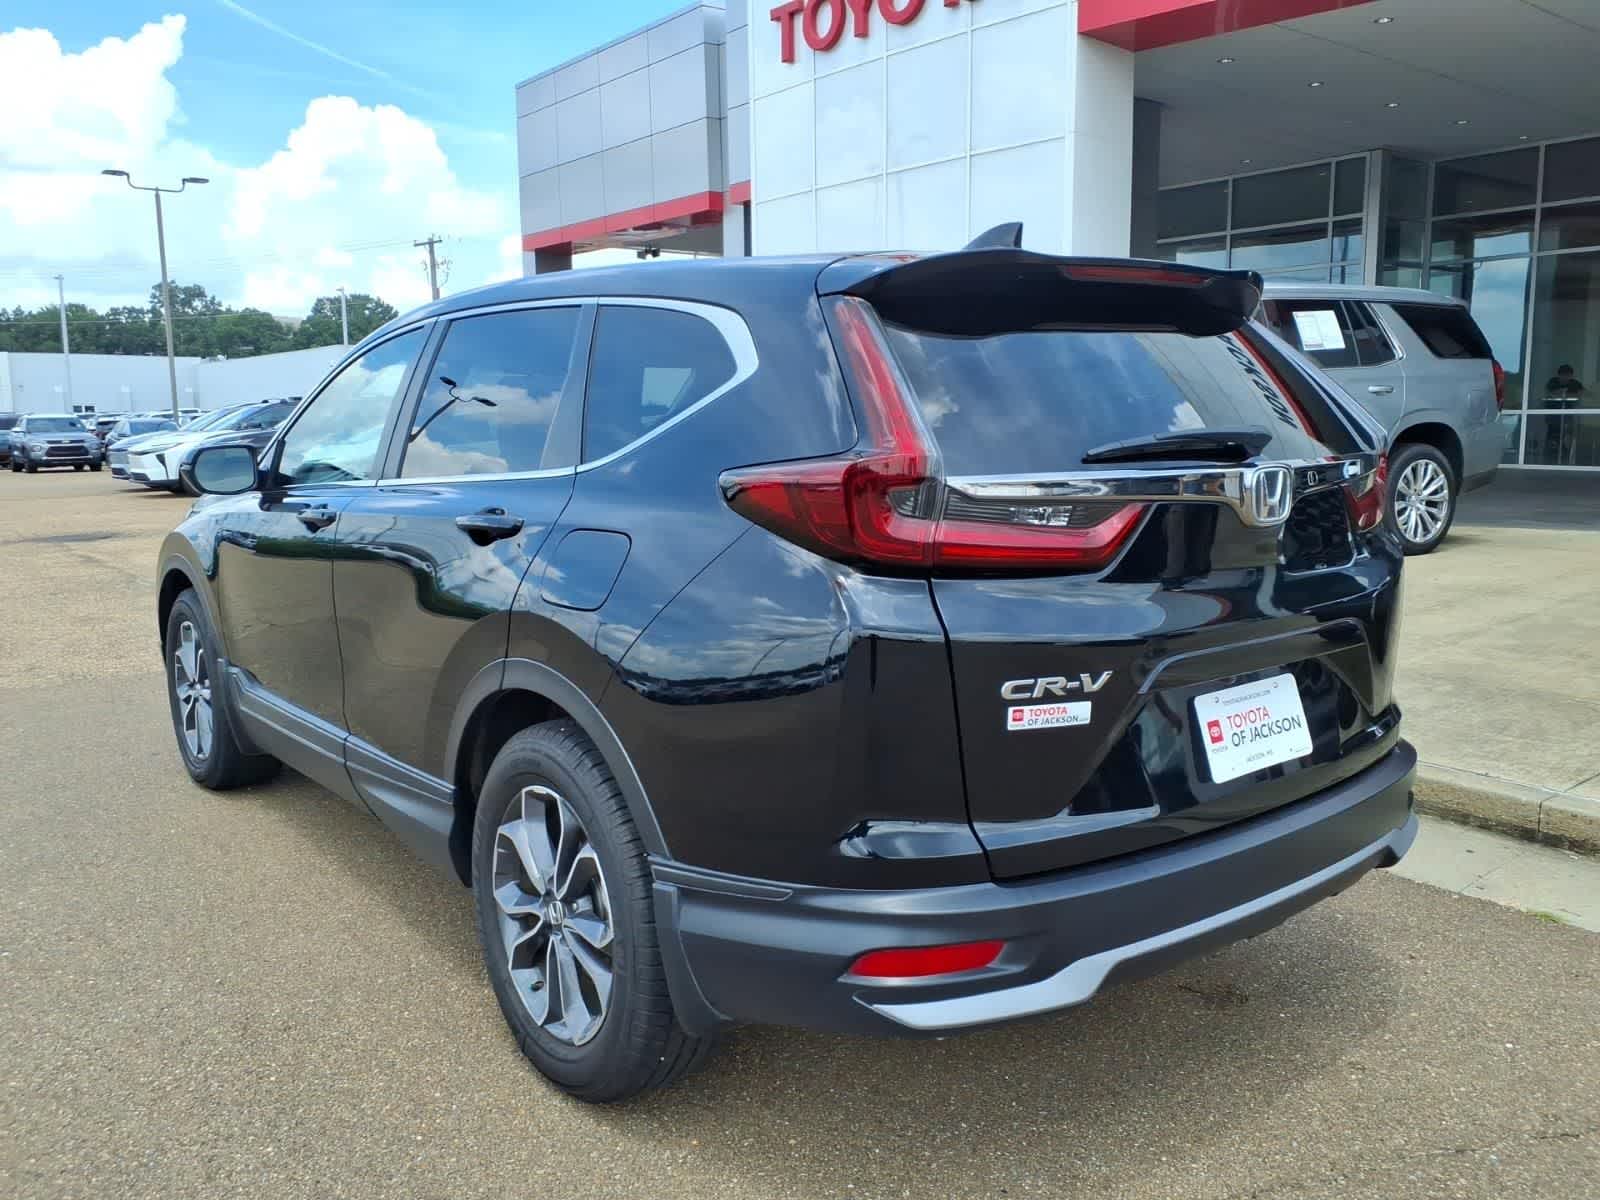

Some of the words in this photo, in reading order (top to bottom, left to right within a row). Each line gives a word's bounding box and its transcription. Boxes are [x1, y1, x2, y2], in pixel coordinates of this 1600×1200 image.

[770, 0, 961, 64] TOY
[1001, 670, 1113, 700] CR-V
[1027, 718, 1039, 726] OF
[1040, 715, 1079, 725] JACKSON
[1029, 706, 1068, 717] TOYOTA
[1226, 706, 1270, 729] TOYOTA
[1231, 730, 1246, 747] OF
[1249, 715, 1302, 743] JACKSON
